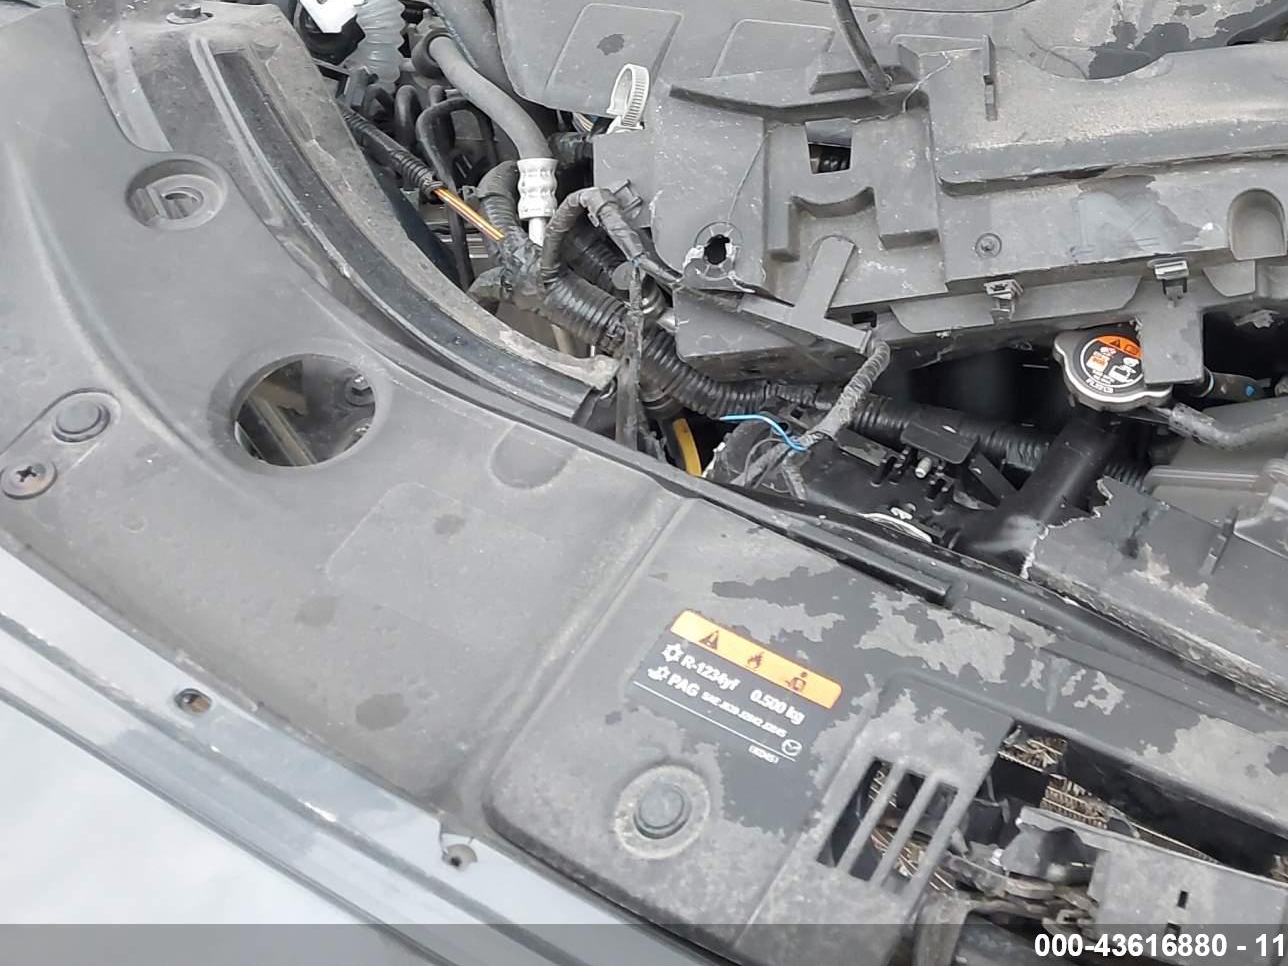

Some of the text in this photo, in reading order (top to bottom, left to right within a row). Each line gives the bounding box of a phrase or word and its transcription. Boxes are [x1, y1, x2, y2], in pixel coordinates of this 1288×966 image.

[667, 673, 700, 697] PAG
[681, 655, 741, 690] R-1234yf
[750, 689, 787, 714] 0.500
[786, 703, 806, 725] kg
